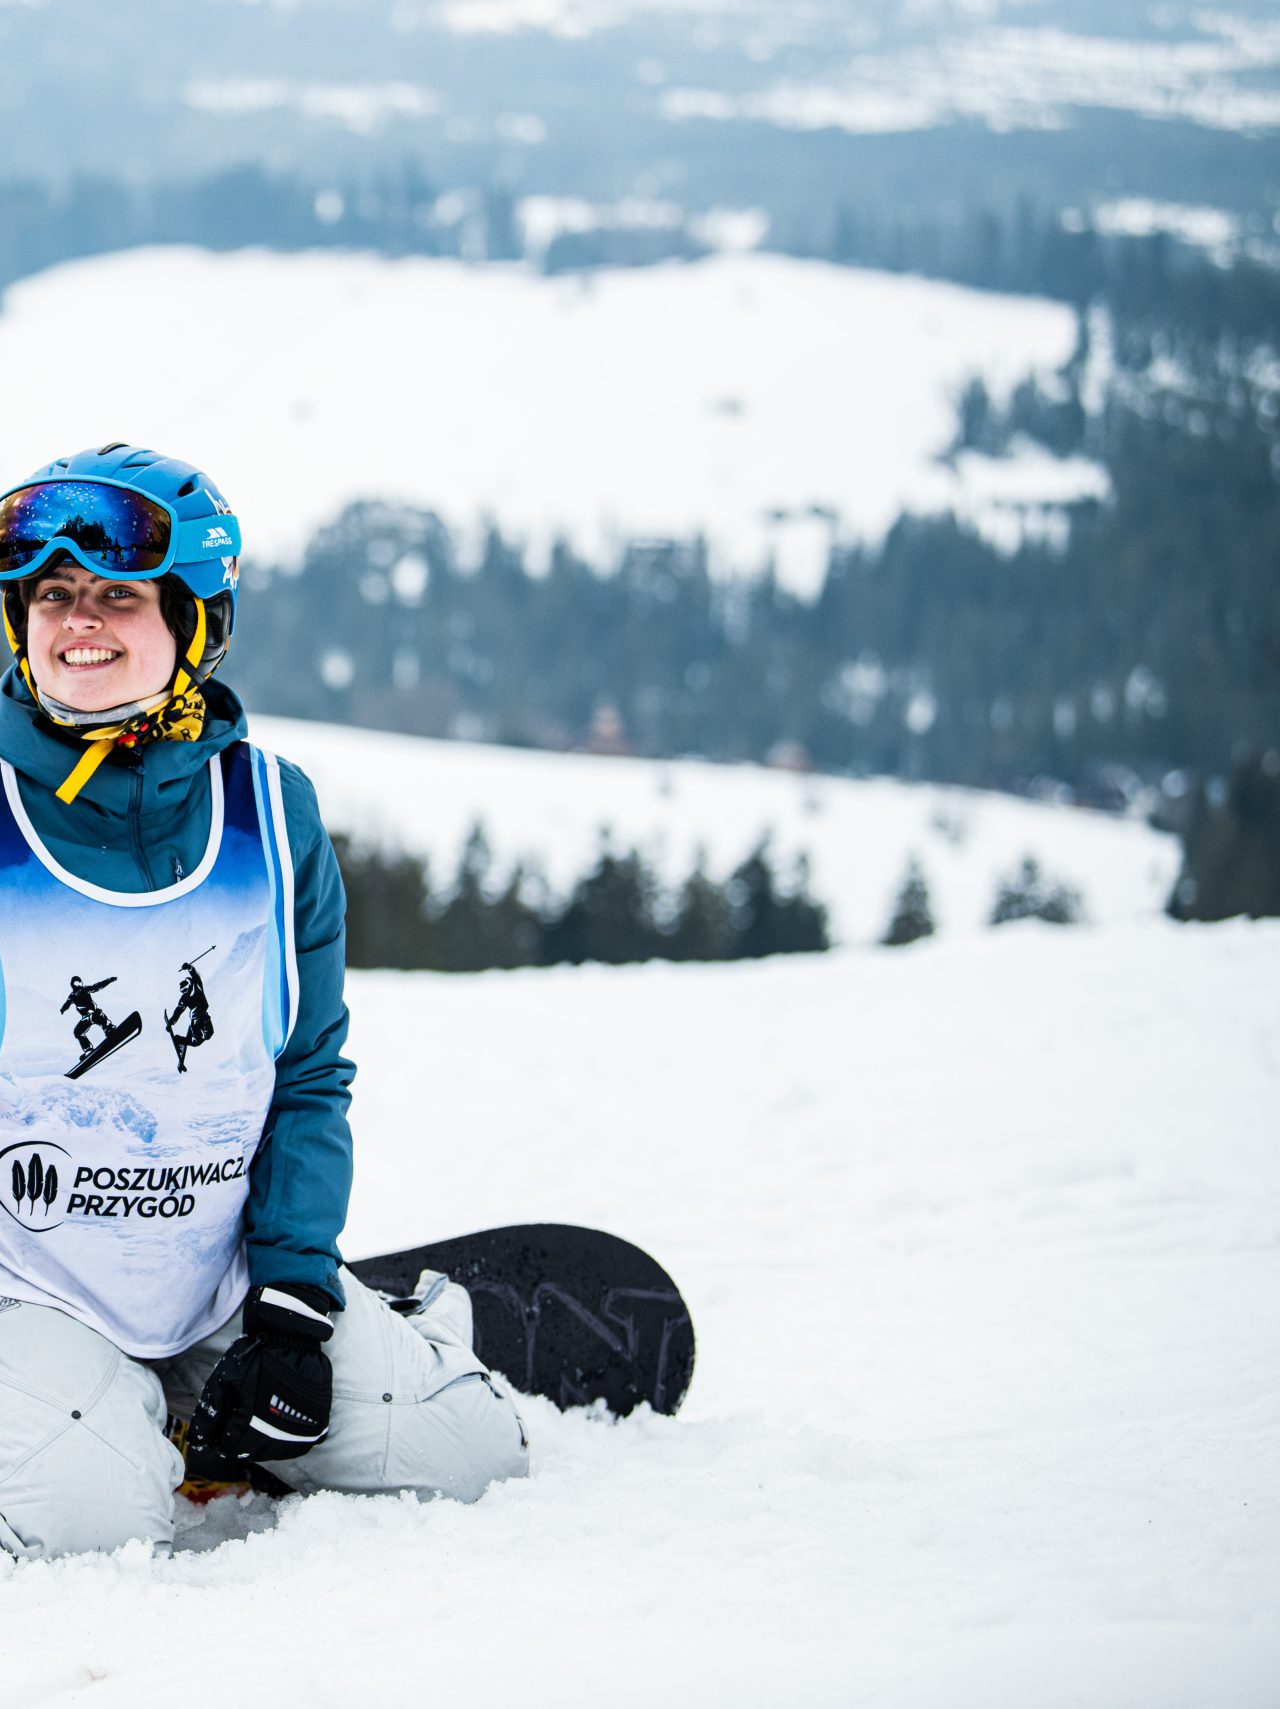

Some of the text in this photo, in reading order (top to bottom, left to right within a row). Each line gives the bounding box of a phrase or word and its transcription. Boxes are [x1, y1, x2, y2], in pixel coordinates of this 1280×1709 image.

[201, 536, 233, 549] TRESPASS
[73, 1156, 247, 1191] POSZUKIWACZ
[66, 1188, 196, 1218] PRZYGÓD
